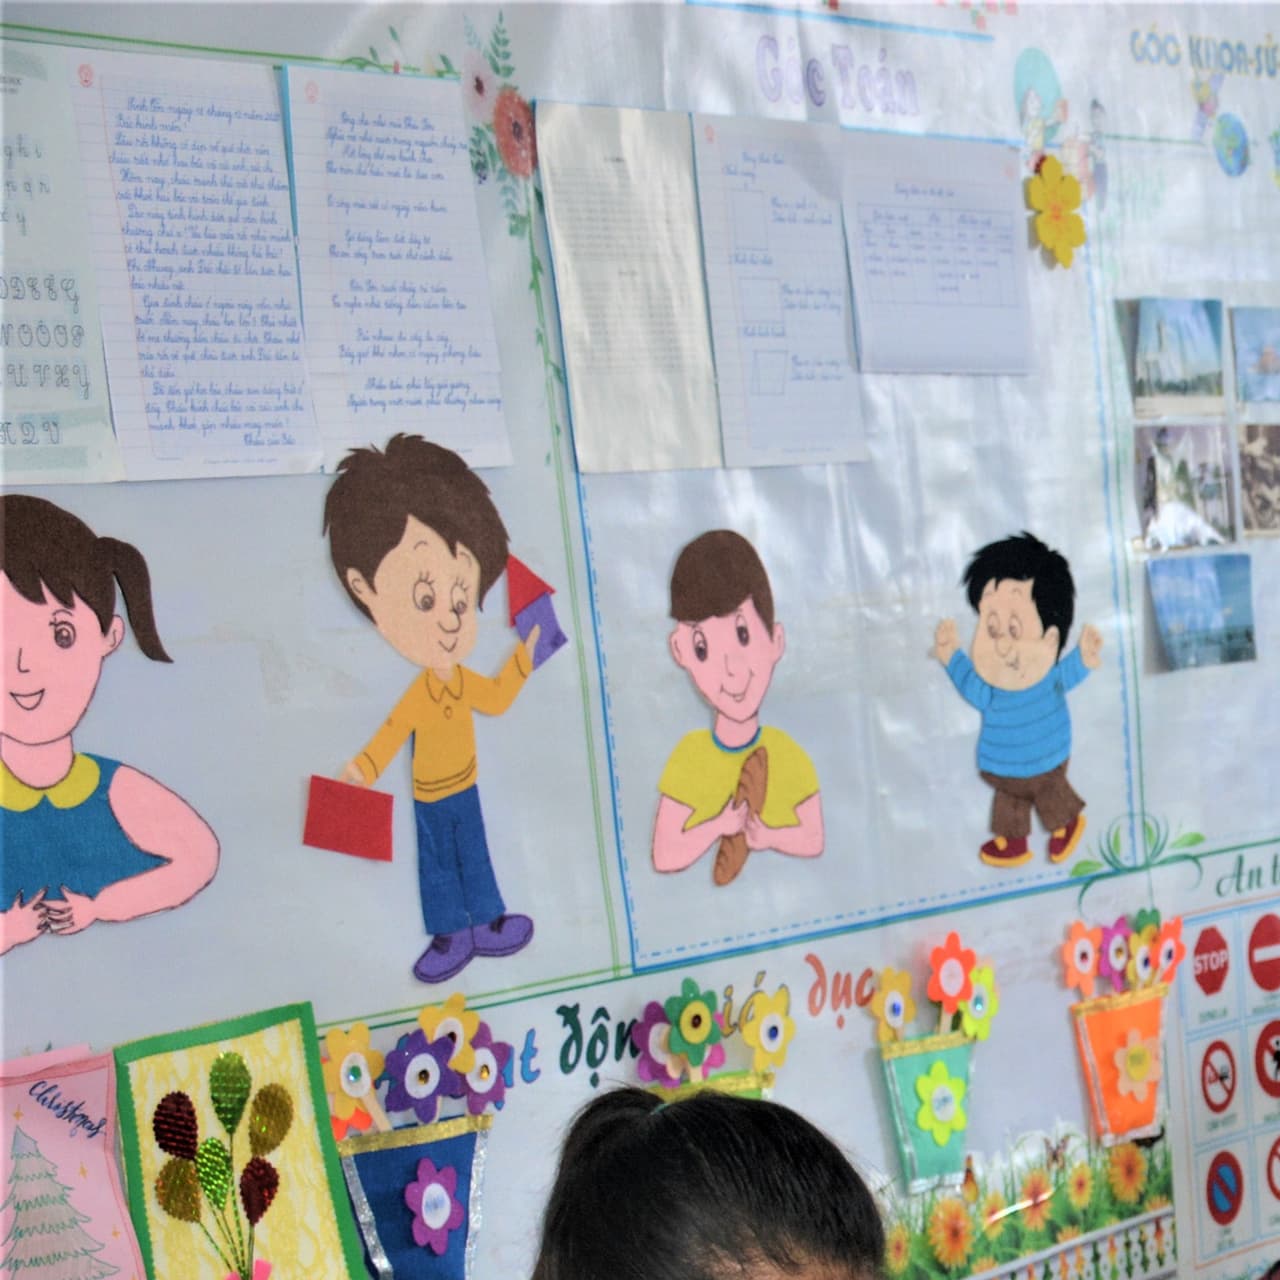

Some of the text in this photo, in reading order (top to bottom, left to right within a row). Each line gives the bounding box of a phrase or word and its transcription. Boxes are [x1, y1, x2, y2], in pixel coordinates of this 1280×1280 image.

[1216, 854, 1262, 897] An
[1193, 950, 1229, 975] STOP
[555, 1003, 642, 1088] độn
